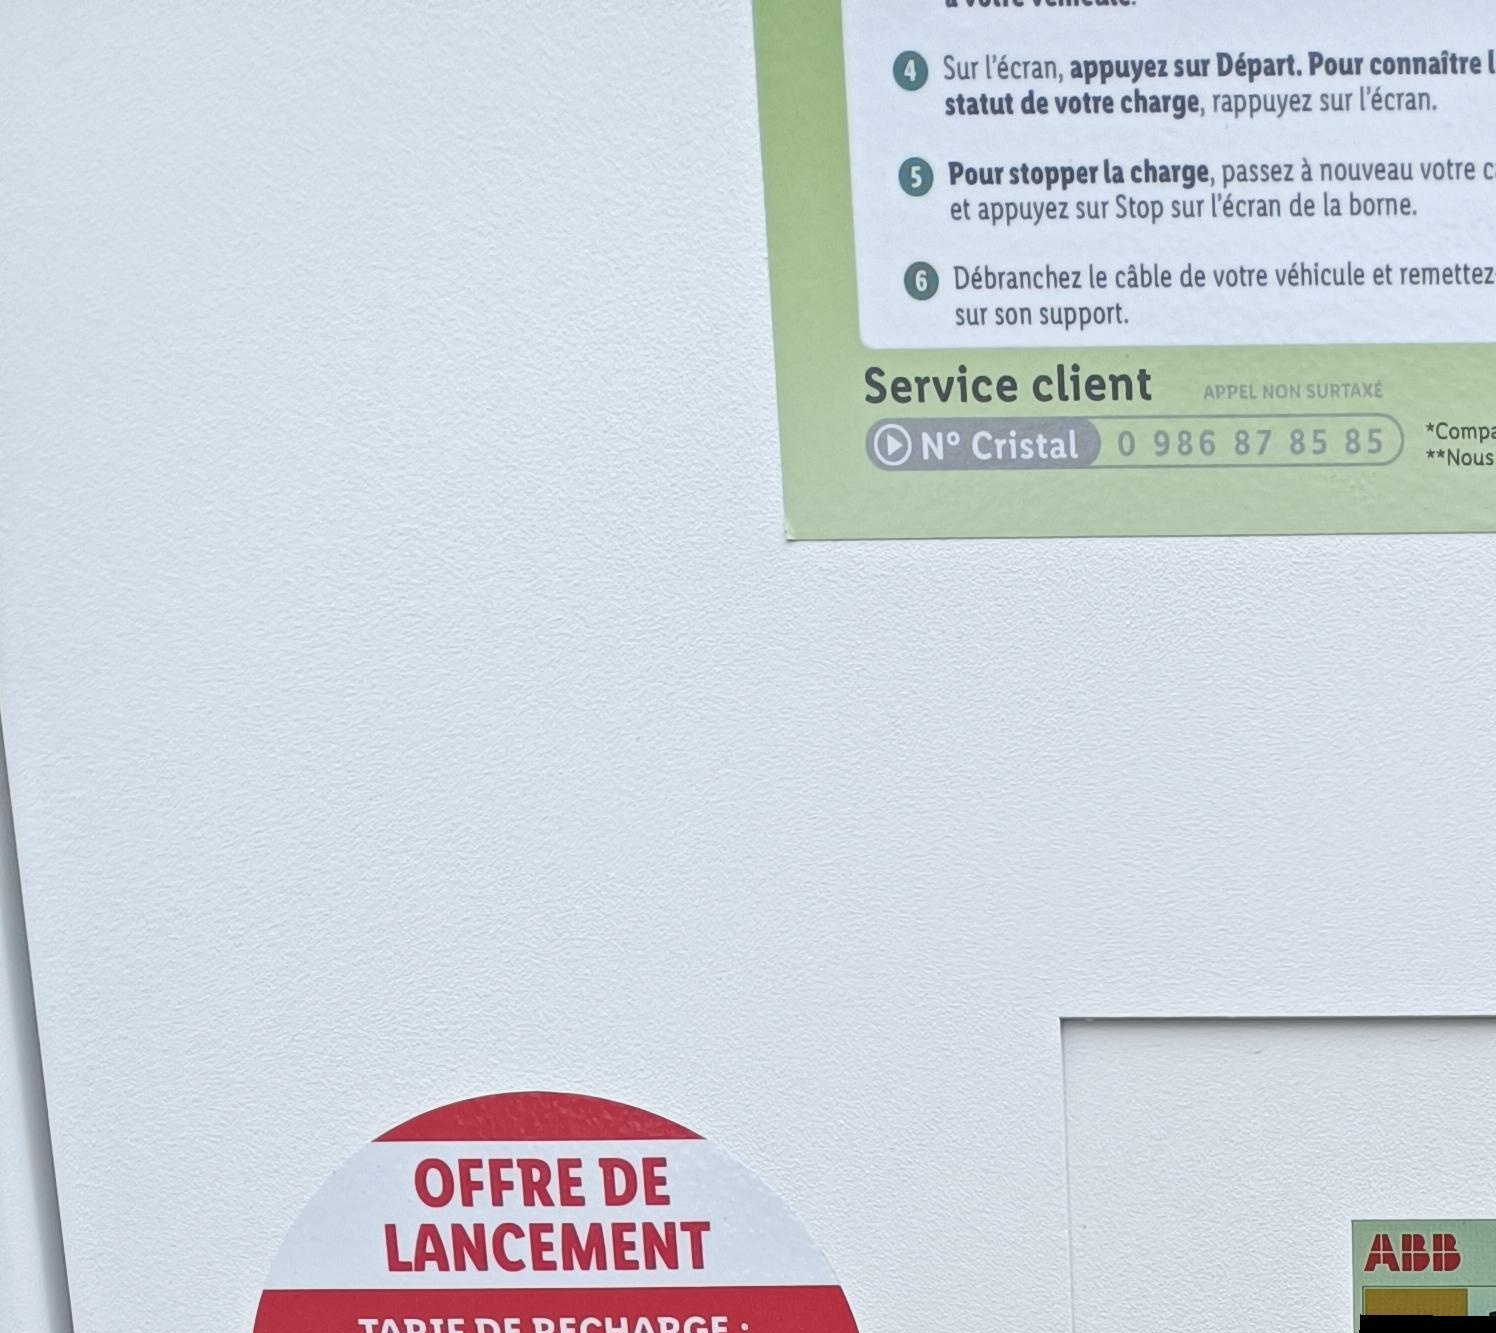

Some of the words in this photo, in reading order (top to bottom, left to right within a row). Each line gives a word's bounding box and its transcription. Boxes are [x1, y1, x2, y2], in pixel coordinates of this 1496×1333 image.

[903, 60, 916, 82] 4
[943, 54, 979, 81] Sur
[1070, 58, 1169, 85] appuyez
[1173, 58, 1211, 78] sur
[1215, 51, 1303, 84] Départ.
[1307, 51, 1364, 77] Pour
[1369, 49, 1482, 76] connaître
[910, 165, 924, 190] 5
[947, 161, 1005, 186] Pour
[1008, 162, 1099, 191] stopper
[1103, 158, 1125, 185] la
[1130, 158, 1215, 190] charge,
[1221, 163, 1295, 189] passez
[1300, 157, 1313, 182] à
[1319, 162, 1414, 182] nouveau
[1420, 158, 1476, 181] votre
[914, 269, 929, 294] 6
[953, 263, 1083, 290] Débranchez
[1088, 263, 1108, 289] le
[1115, 263, 1173, 289] câble
[1179, 262, 1206, 288] de
[1212, 265, 1268, 288] votre
[1274, 260, 1365, 287] véhicule
[1372, 263, 1393, 286] et
[864, 364, 1018, 405] Service
[1032, 362, 1152, 403] client
[1203, 383, 1258, 401] APPEL
[1262, 383, 1301, 400] NON
[1305, 379, 1384, 400] SURTAXÉ
[971, 429, 1079, 461] Cristal
[1117, 430, 1136, 458] 0
[1153, 428, 1216, 458] 986
[1234, 428, 1273, 456] 87
[1289, 428, 1327, 456] 85
[1345, 427, 1383, 455] 85
[414, 1157, 586, 1209] OFFRE
[597, 1156, 671, 1207] DE
[384, 1220, 711, 1273] LANCEMENT
[1362, 1232, 1462, 1272] ABB
